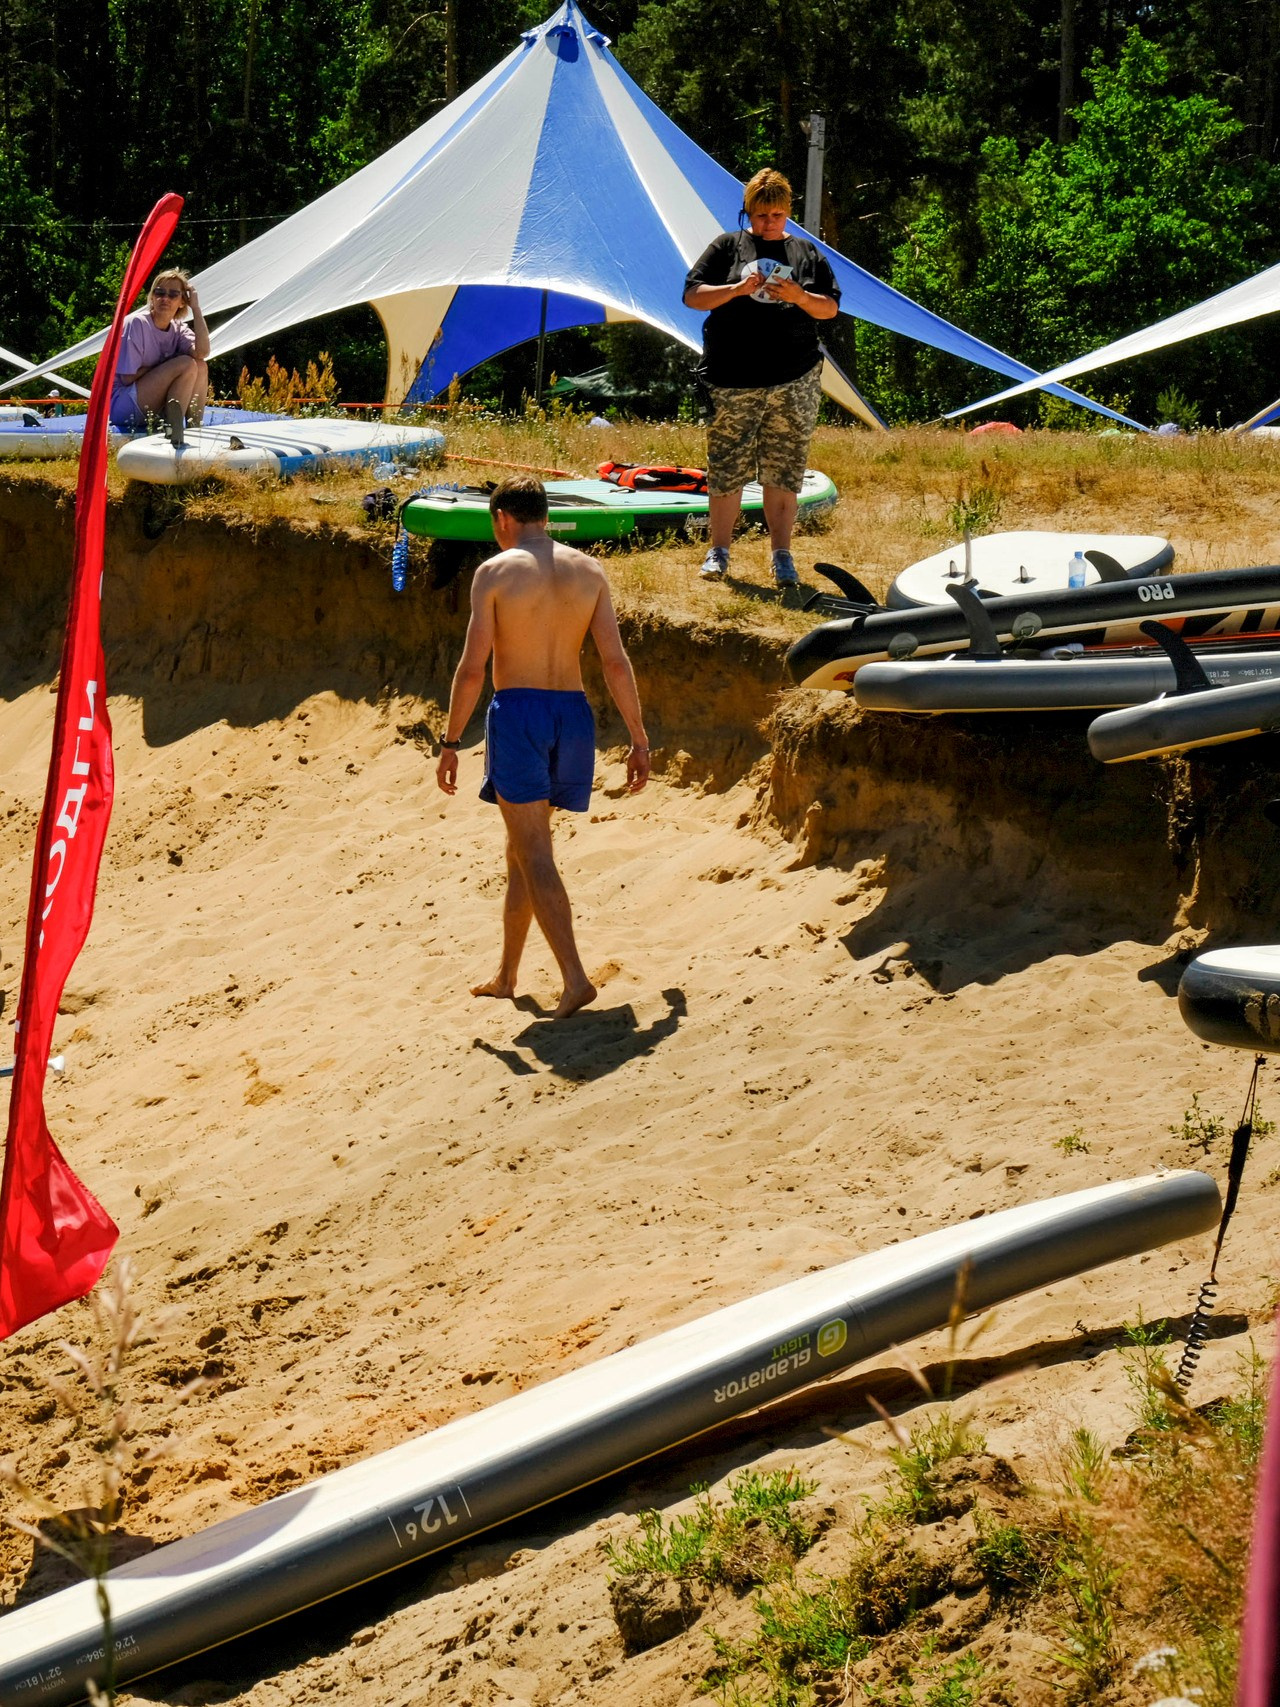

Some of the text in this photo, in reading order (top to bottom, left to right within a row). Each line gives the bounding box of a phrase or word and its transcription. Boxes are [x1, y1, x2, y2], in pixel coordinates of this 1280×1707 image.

[1137, 582, 1175, 602] PRO
[771, 1332, 811, 1361] LIGHT
[41, 1677, 67, 1693] WIDTH
